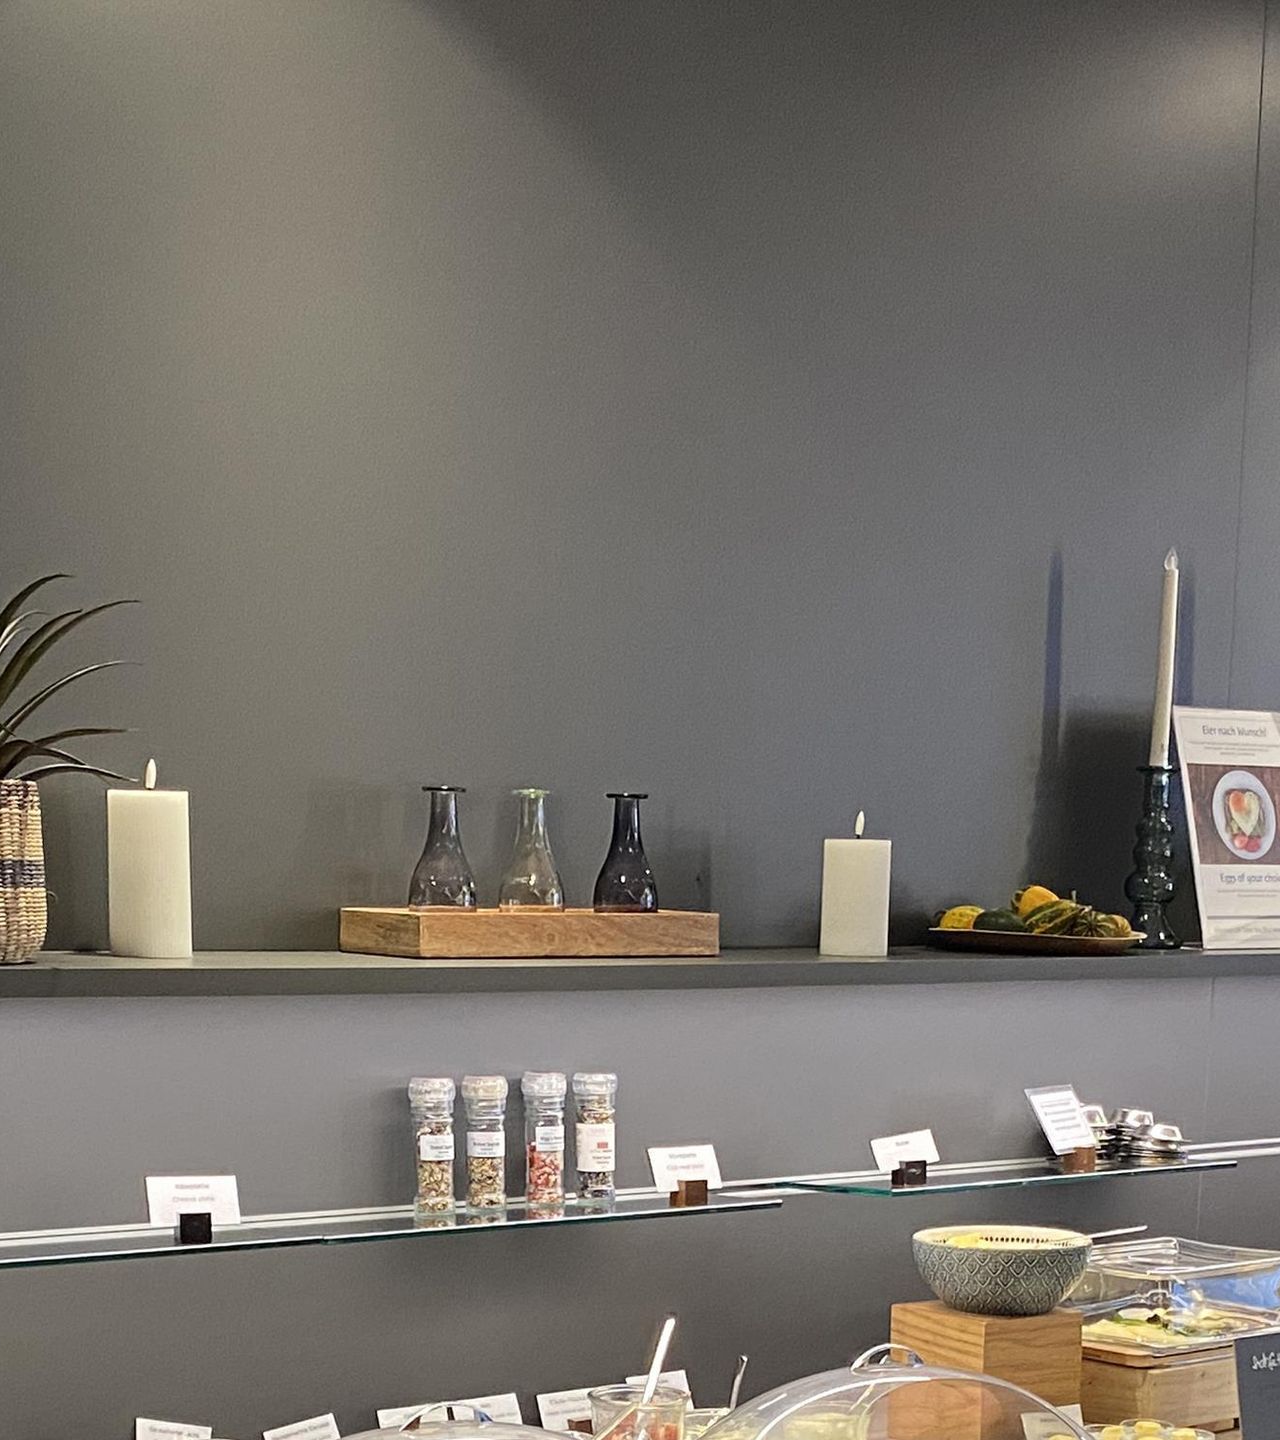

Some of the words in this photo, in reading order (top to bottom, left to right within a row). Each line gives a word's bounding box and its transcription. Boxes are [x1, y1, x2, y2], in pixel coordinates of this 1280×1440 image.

[1202, 725, 1216, 736] Eier
[1218, 726, 1236, 736] nach
[1237, 727, 1267, 737] Wunsch!
[1219, 872, 1236, 884] Eggs
[1238, 873, 1246, 882] of
[1247, 875, 1263, 884] your
